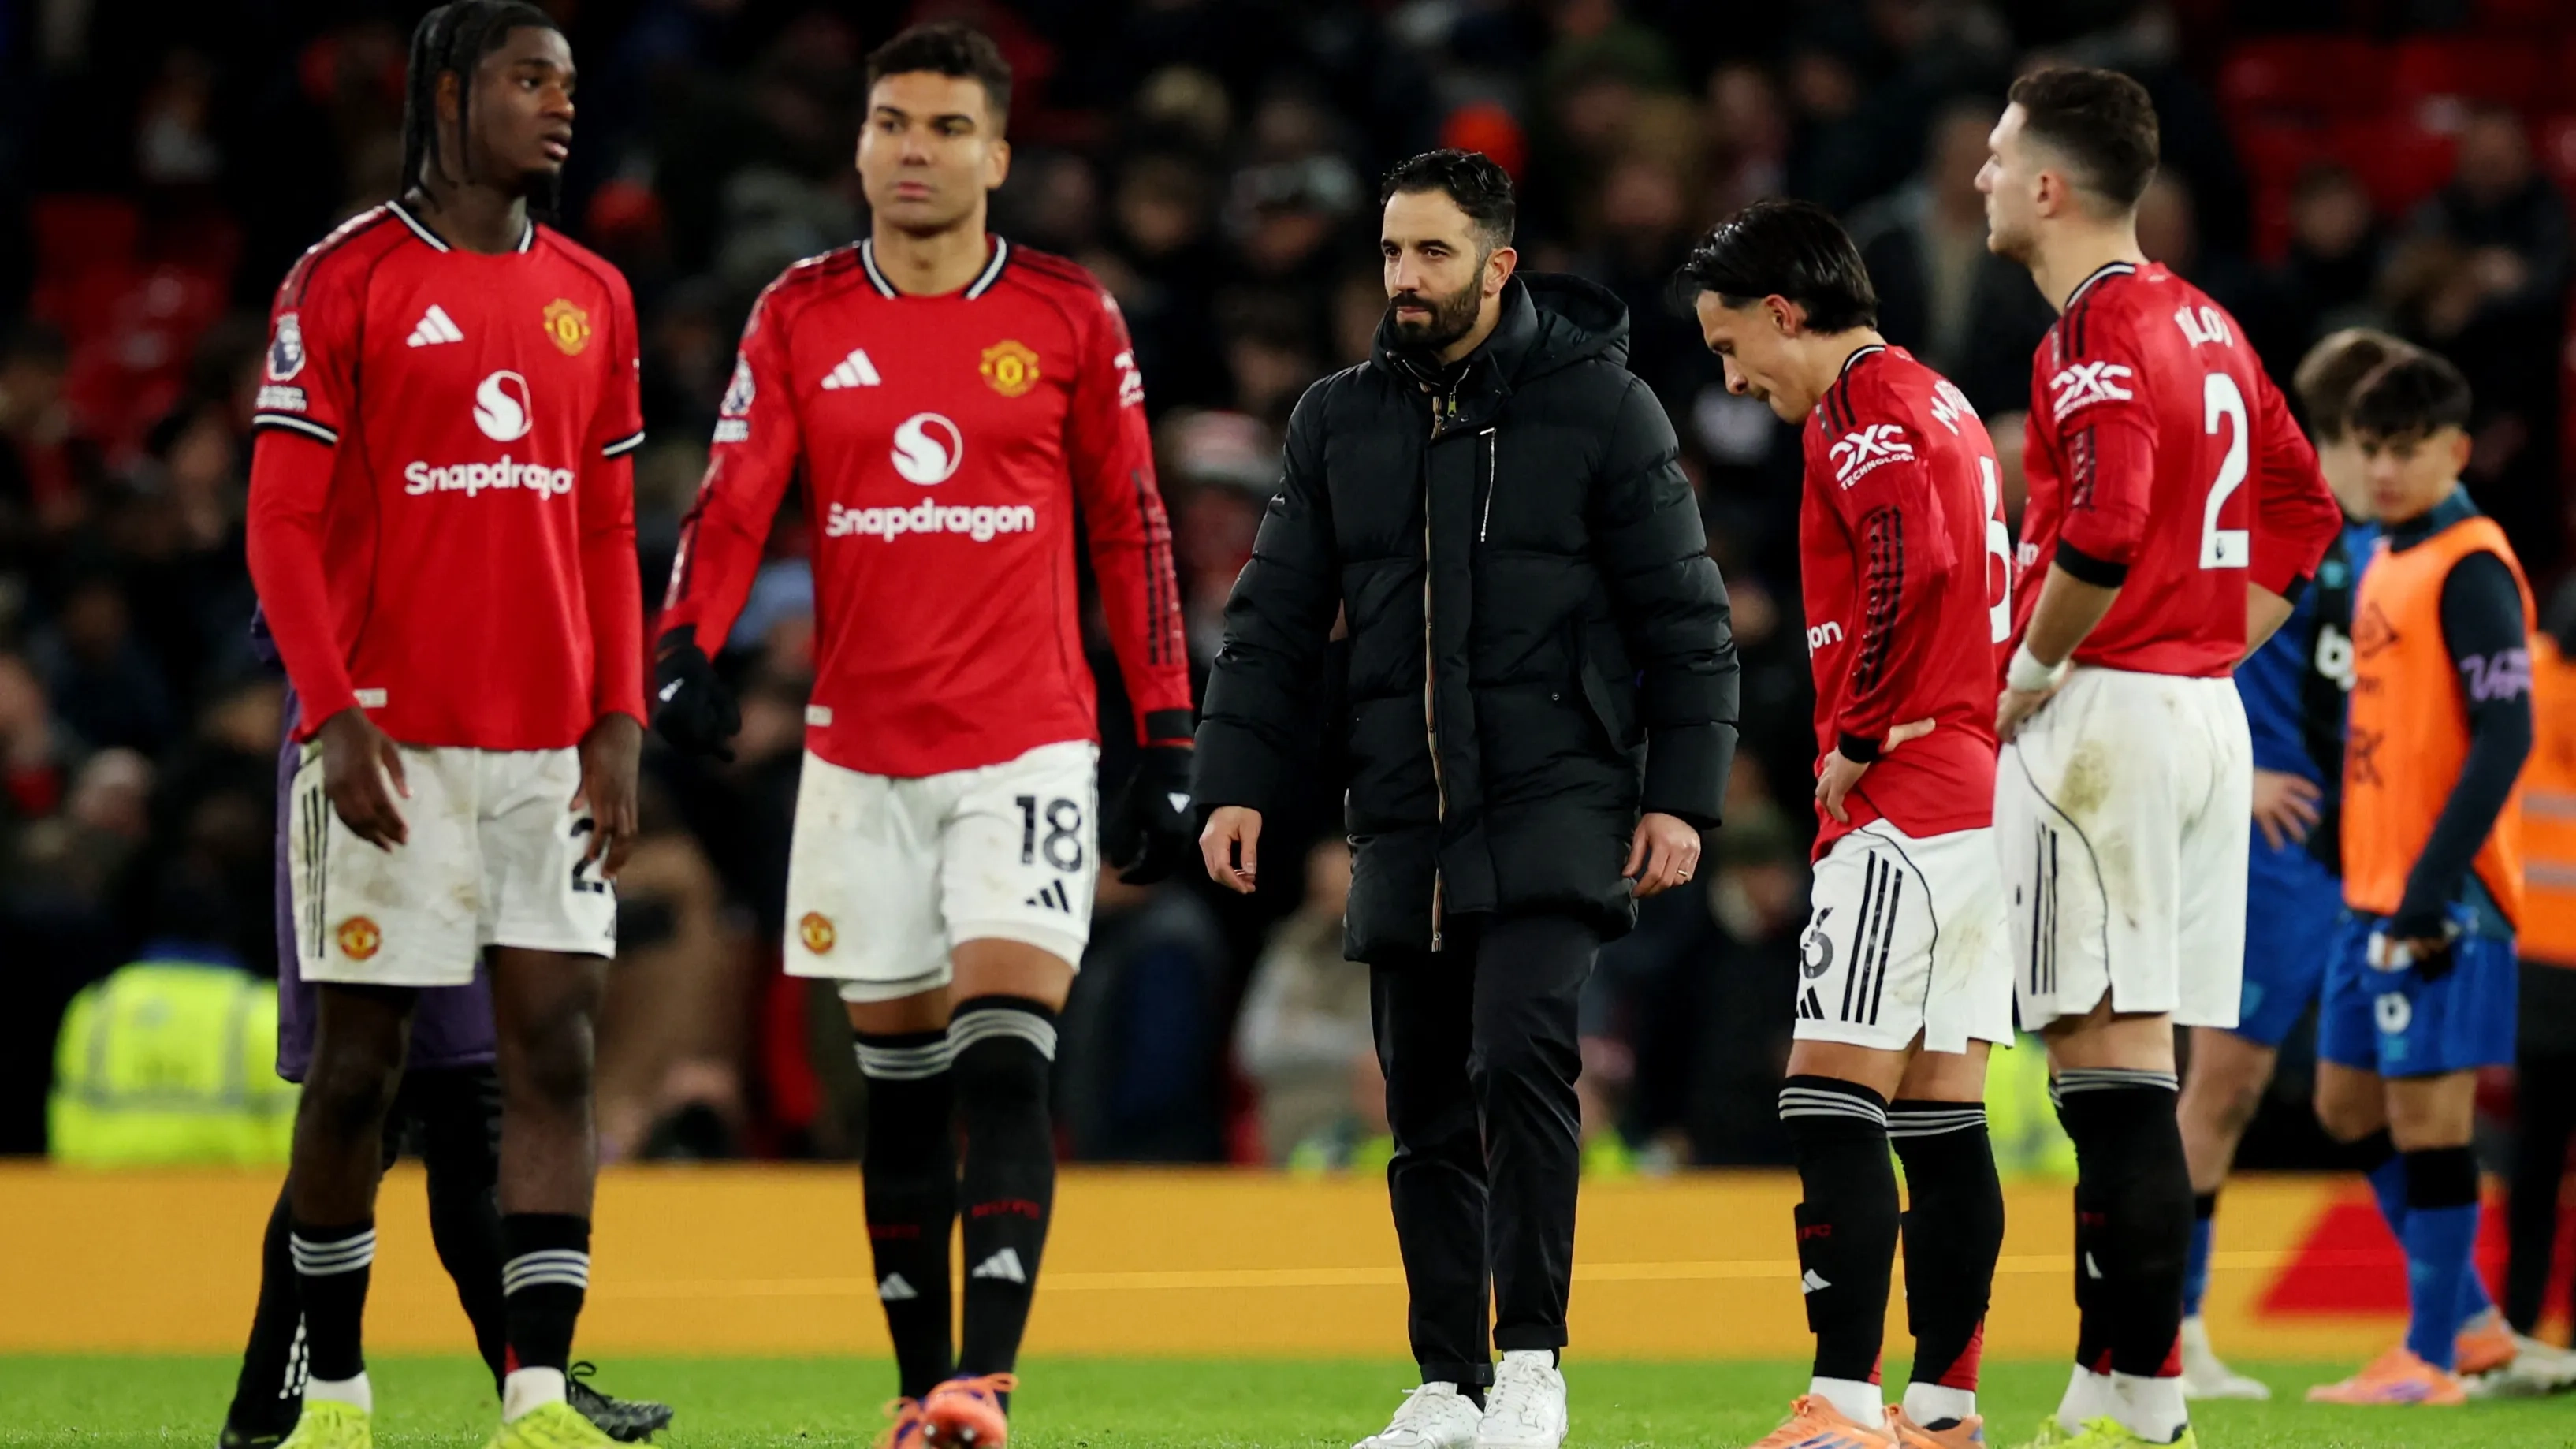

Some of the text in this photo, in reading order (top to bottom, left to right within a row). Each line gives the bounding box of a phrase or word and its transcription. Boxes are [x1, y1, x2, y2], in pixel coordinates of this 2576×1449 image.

[2198, 373, 2250, 569] 2
[825, 497, 1036, 543] Snapdragon
[571, 817, 605, 894] 2
[1015, 795, 1083, 873] 18
[1800, 907, 1834, 979] 6
